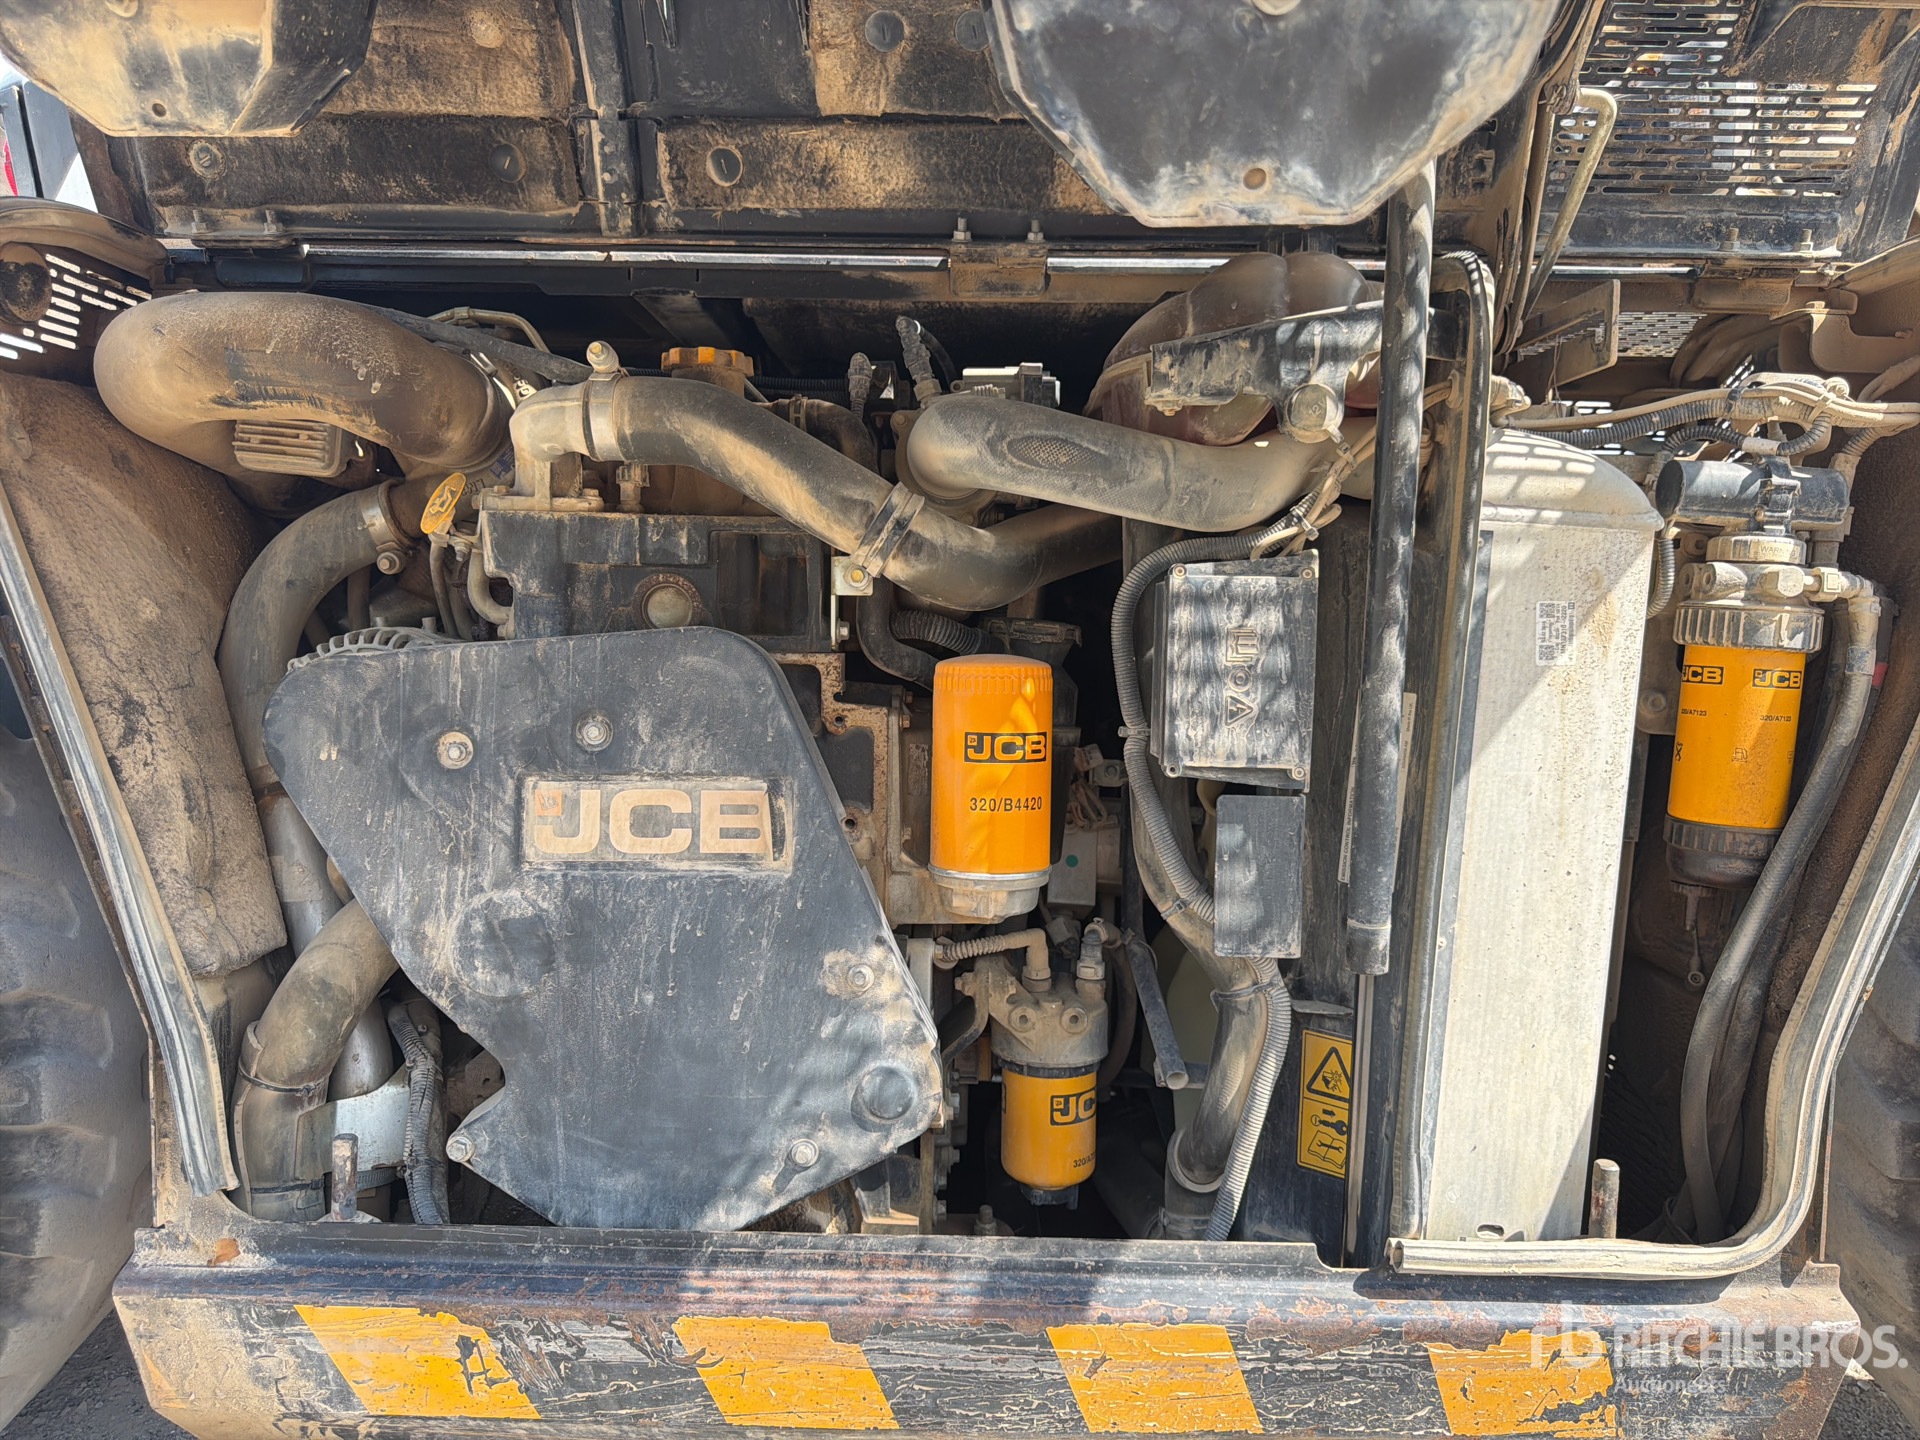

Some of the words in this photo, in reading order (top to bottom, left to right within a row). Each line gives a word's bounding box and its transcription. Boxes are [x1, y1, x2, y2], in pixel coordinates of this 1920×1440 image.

[1754, 669, 1801, 689] JCB
[1760, 714, 1792, 722] 320/A7123
[967, 734, 1046, 761] JCB
[969, 796, 1042, 812] 320/B4420
[534, 788, 770, 855] JCB
[1053, 1089, 1096, 1123] JC
